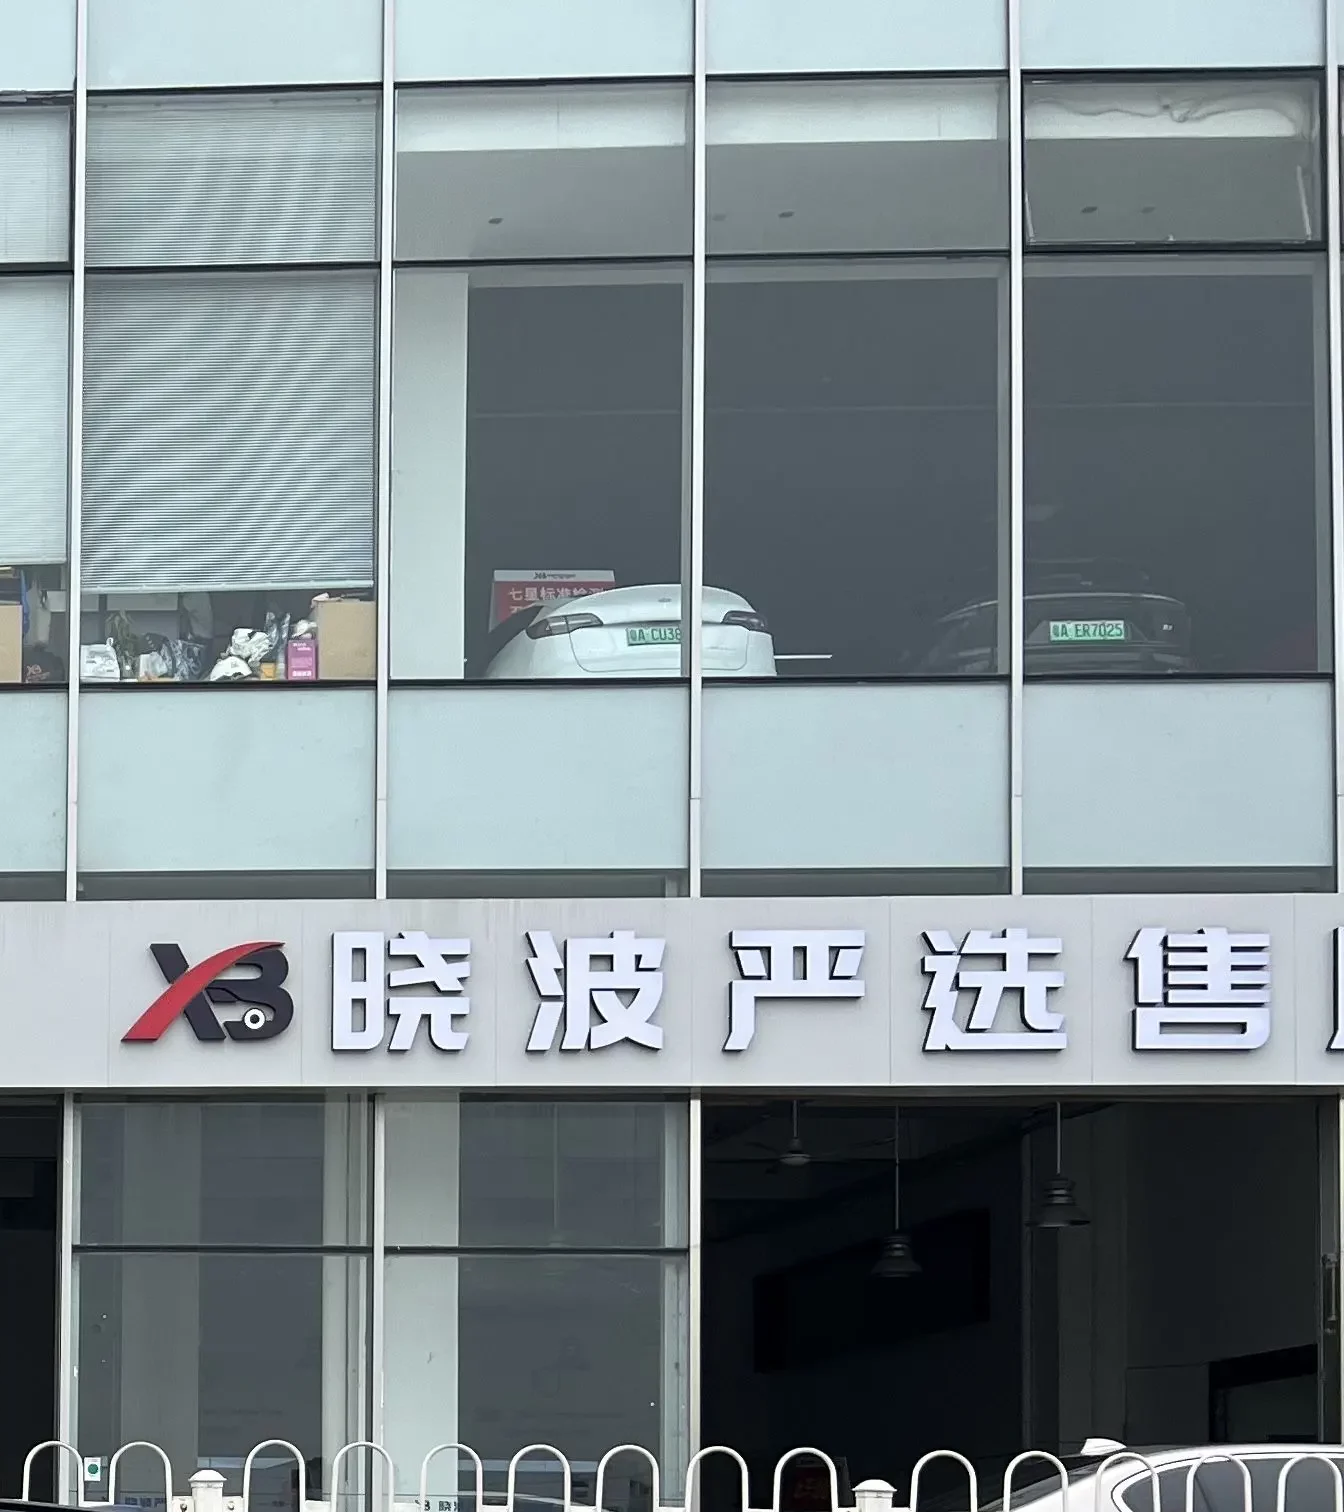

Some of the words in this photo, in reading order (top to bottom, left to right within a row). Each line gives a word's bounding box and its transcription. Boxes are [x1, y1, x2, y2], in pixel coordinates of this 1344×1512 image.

[121, 940, 294, 1042] XB
[331, 926, 1344, 1053] 晓波严选售
